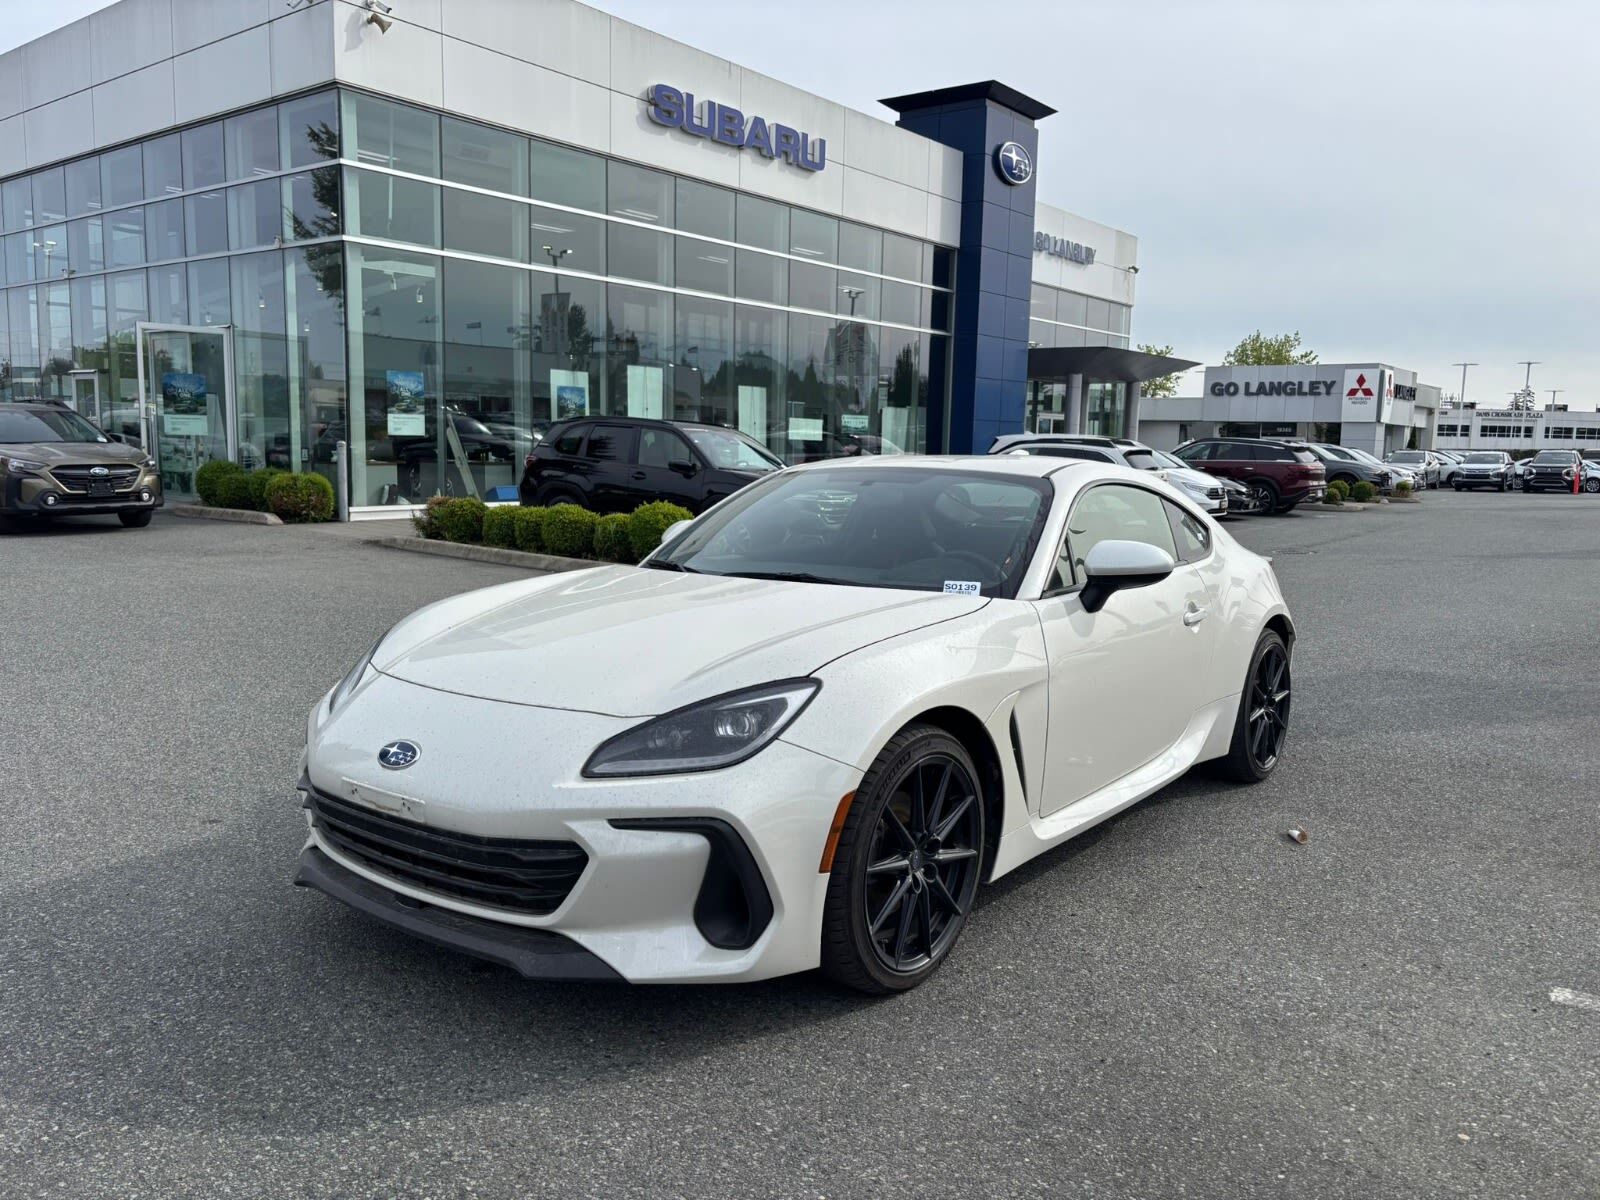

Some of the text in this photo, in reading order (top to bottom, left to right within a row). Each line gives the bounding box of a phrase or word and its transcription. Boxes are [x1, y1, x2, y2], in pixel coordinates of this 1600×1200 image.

[647, 83, 827, 171] SUBARU
[1210, 380, 1336, 397] GO LANGLEY
